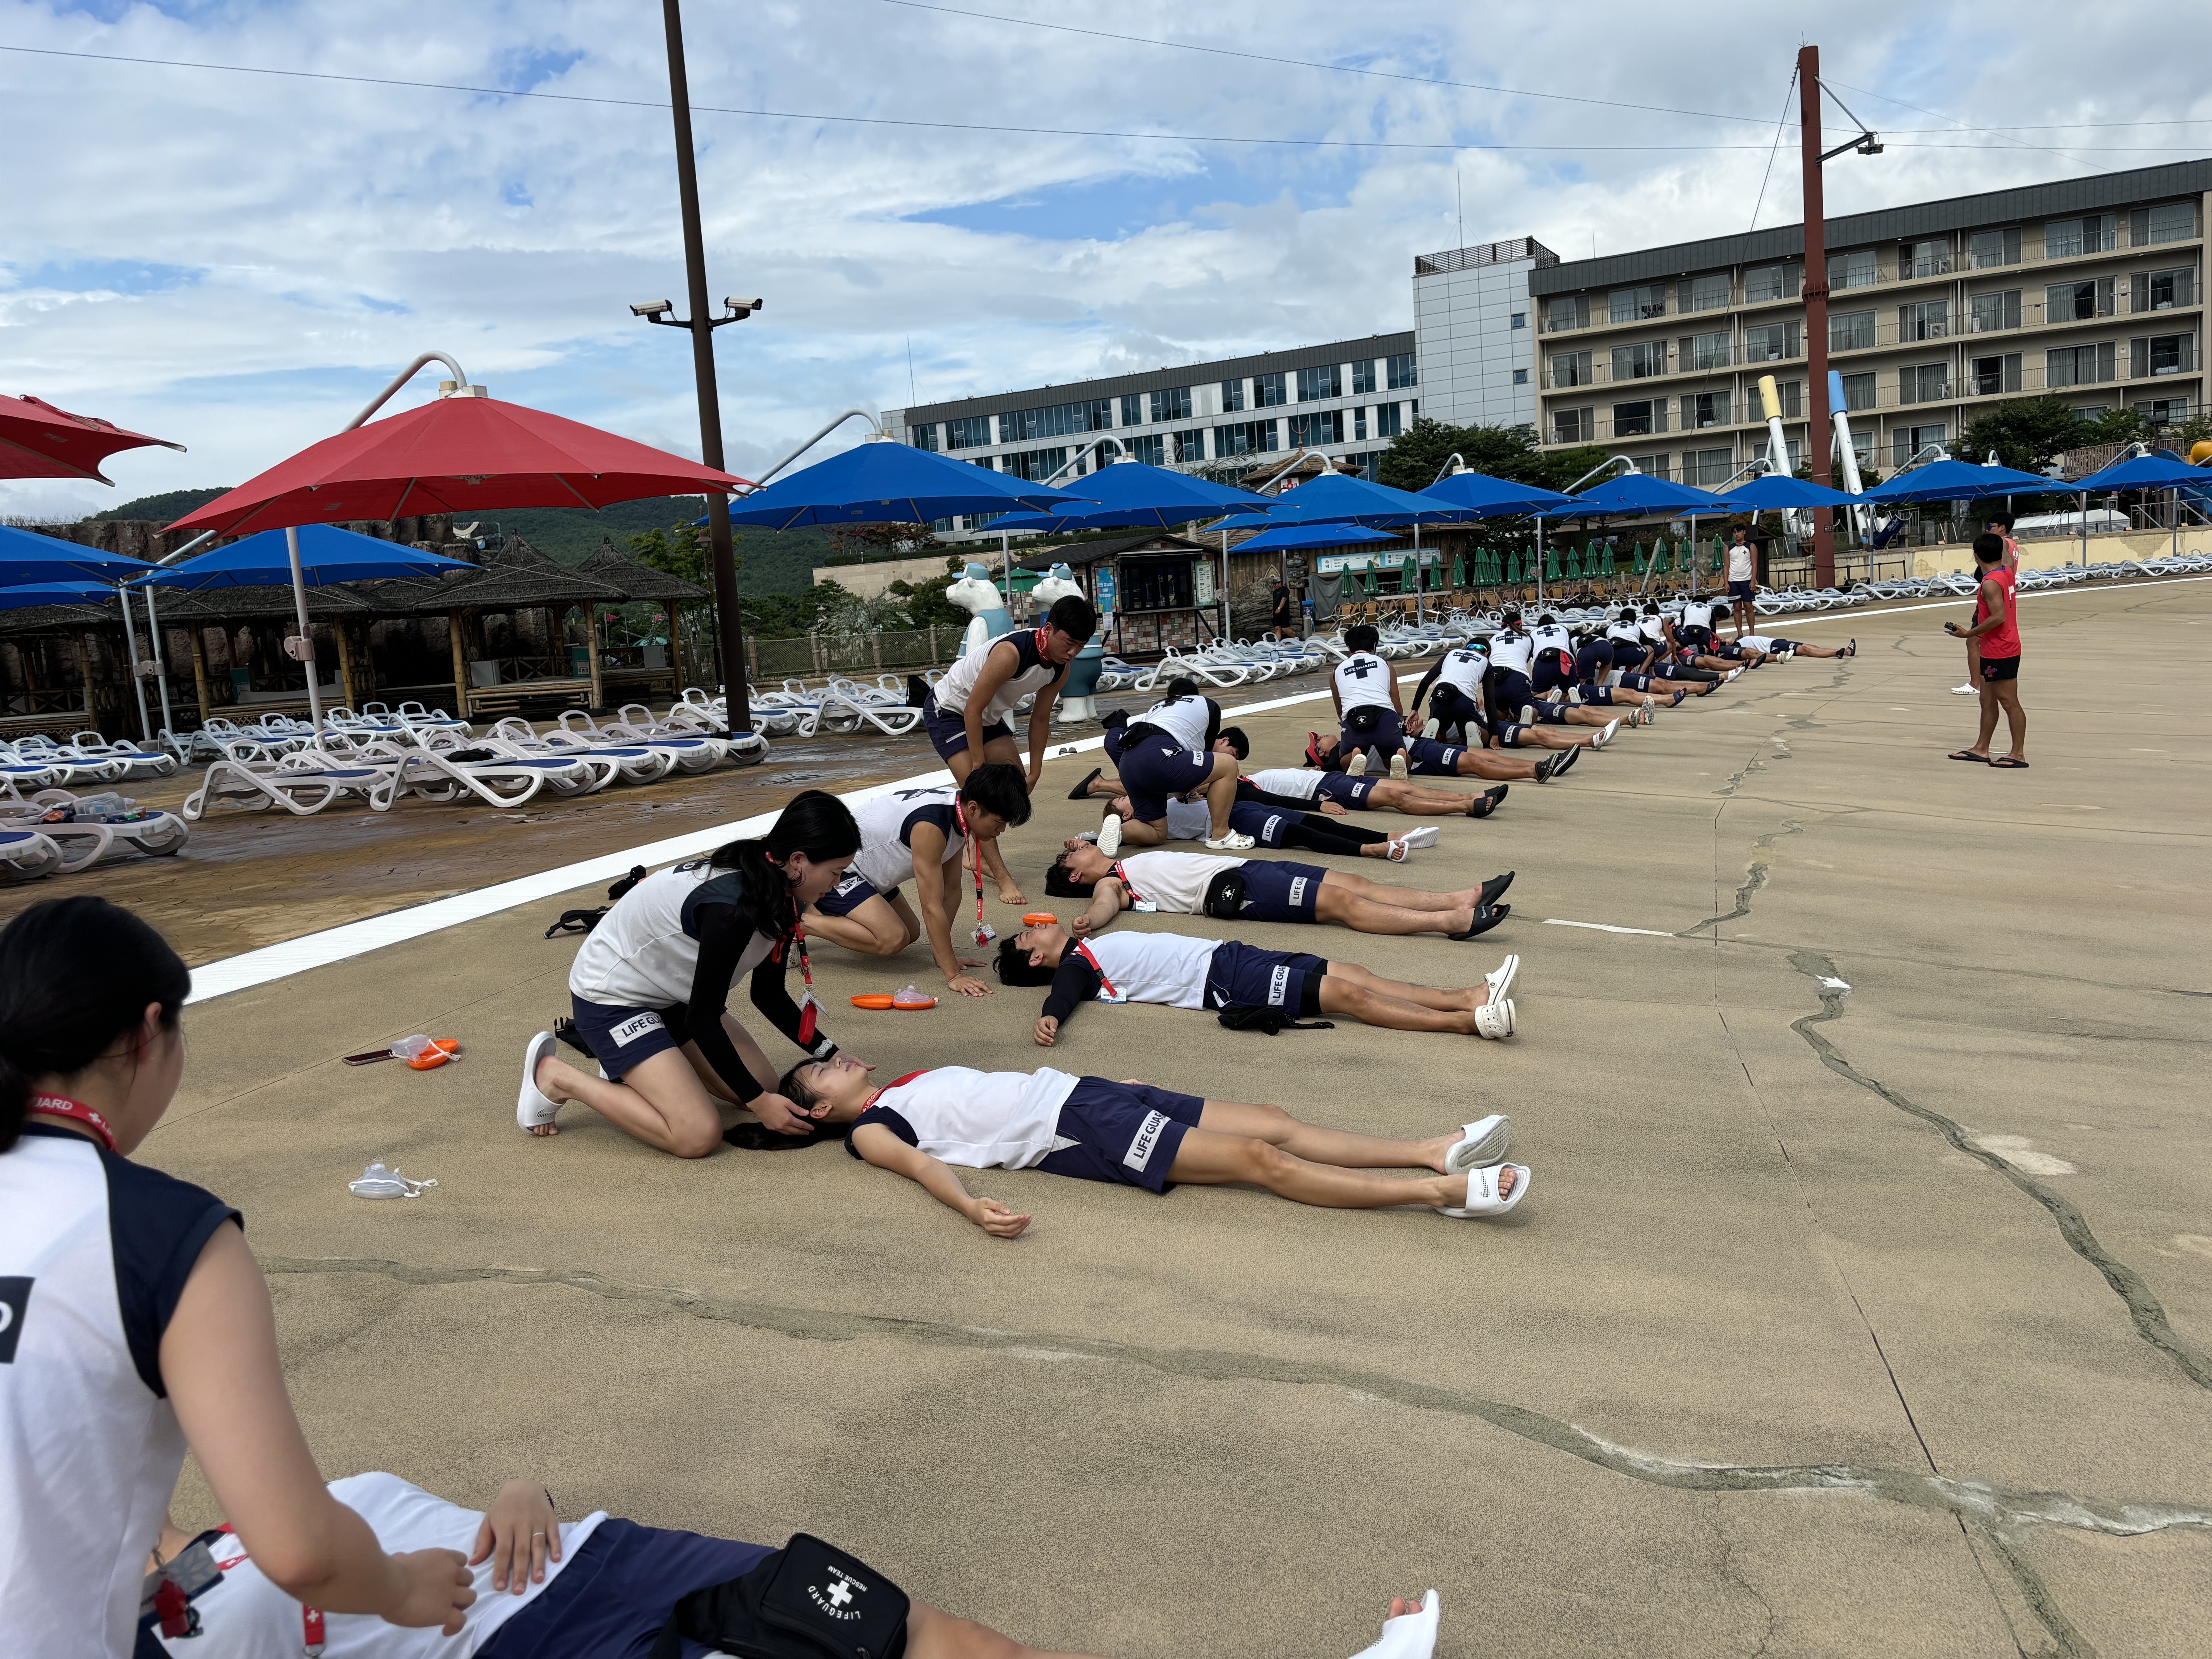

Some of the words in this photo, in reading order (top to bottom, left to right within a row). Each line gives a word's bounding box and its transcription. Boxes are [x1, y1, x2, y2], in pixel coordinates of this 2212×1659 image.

[1273, 981, 1283, 998] LIFE
[621, 1018, 647, 1037] LIFE
[1133, 1133, 1152, 1159] LIFE
[828, 1565, 843, 1578] TEAM
[844, 1574, 867, 1592] RESCUE
[808, 1585, 860, 1620] LIFEGUARD
